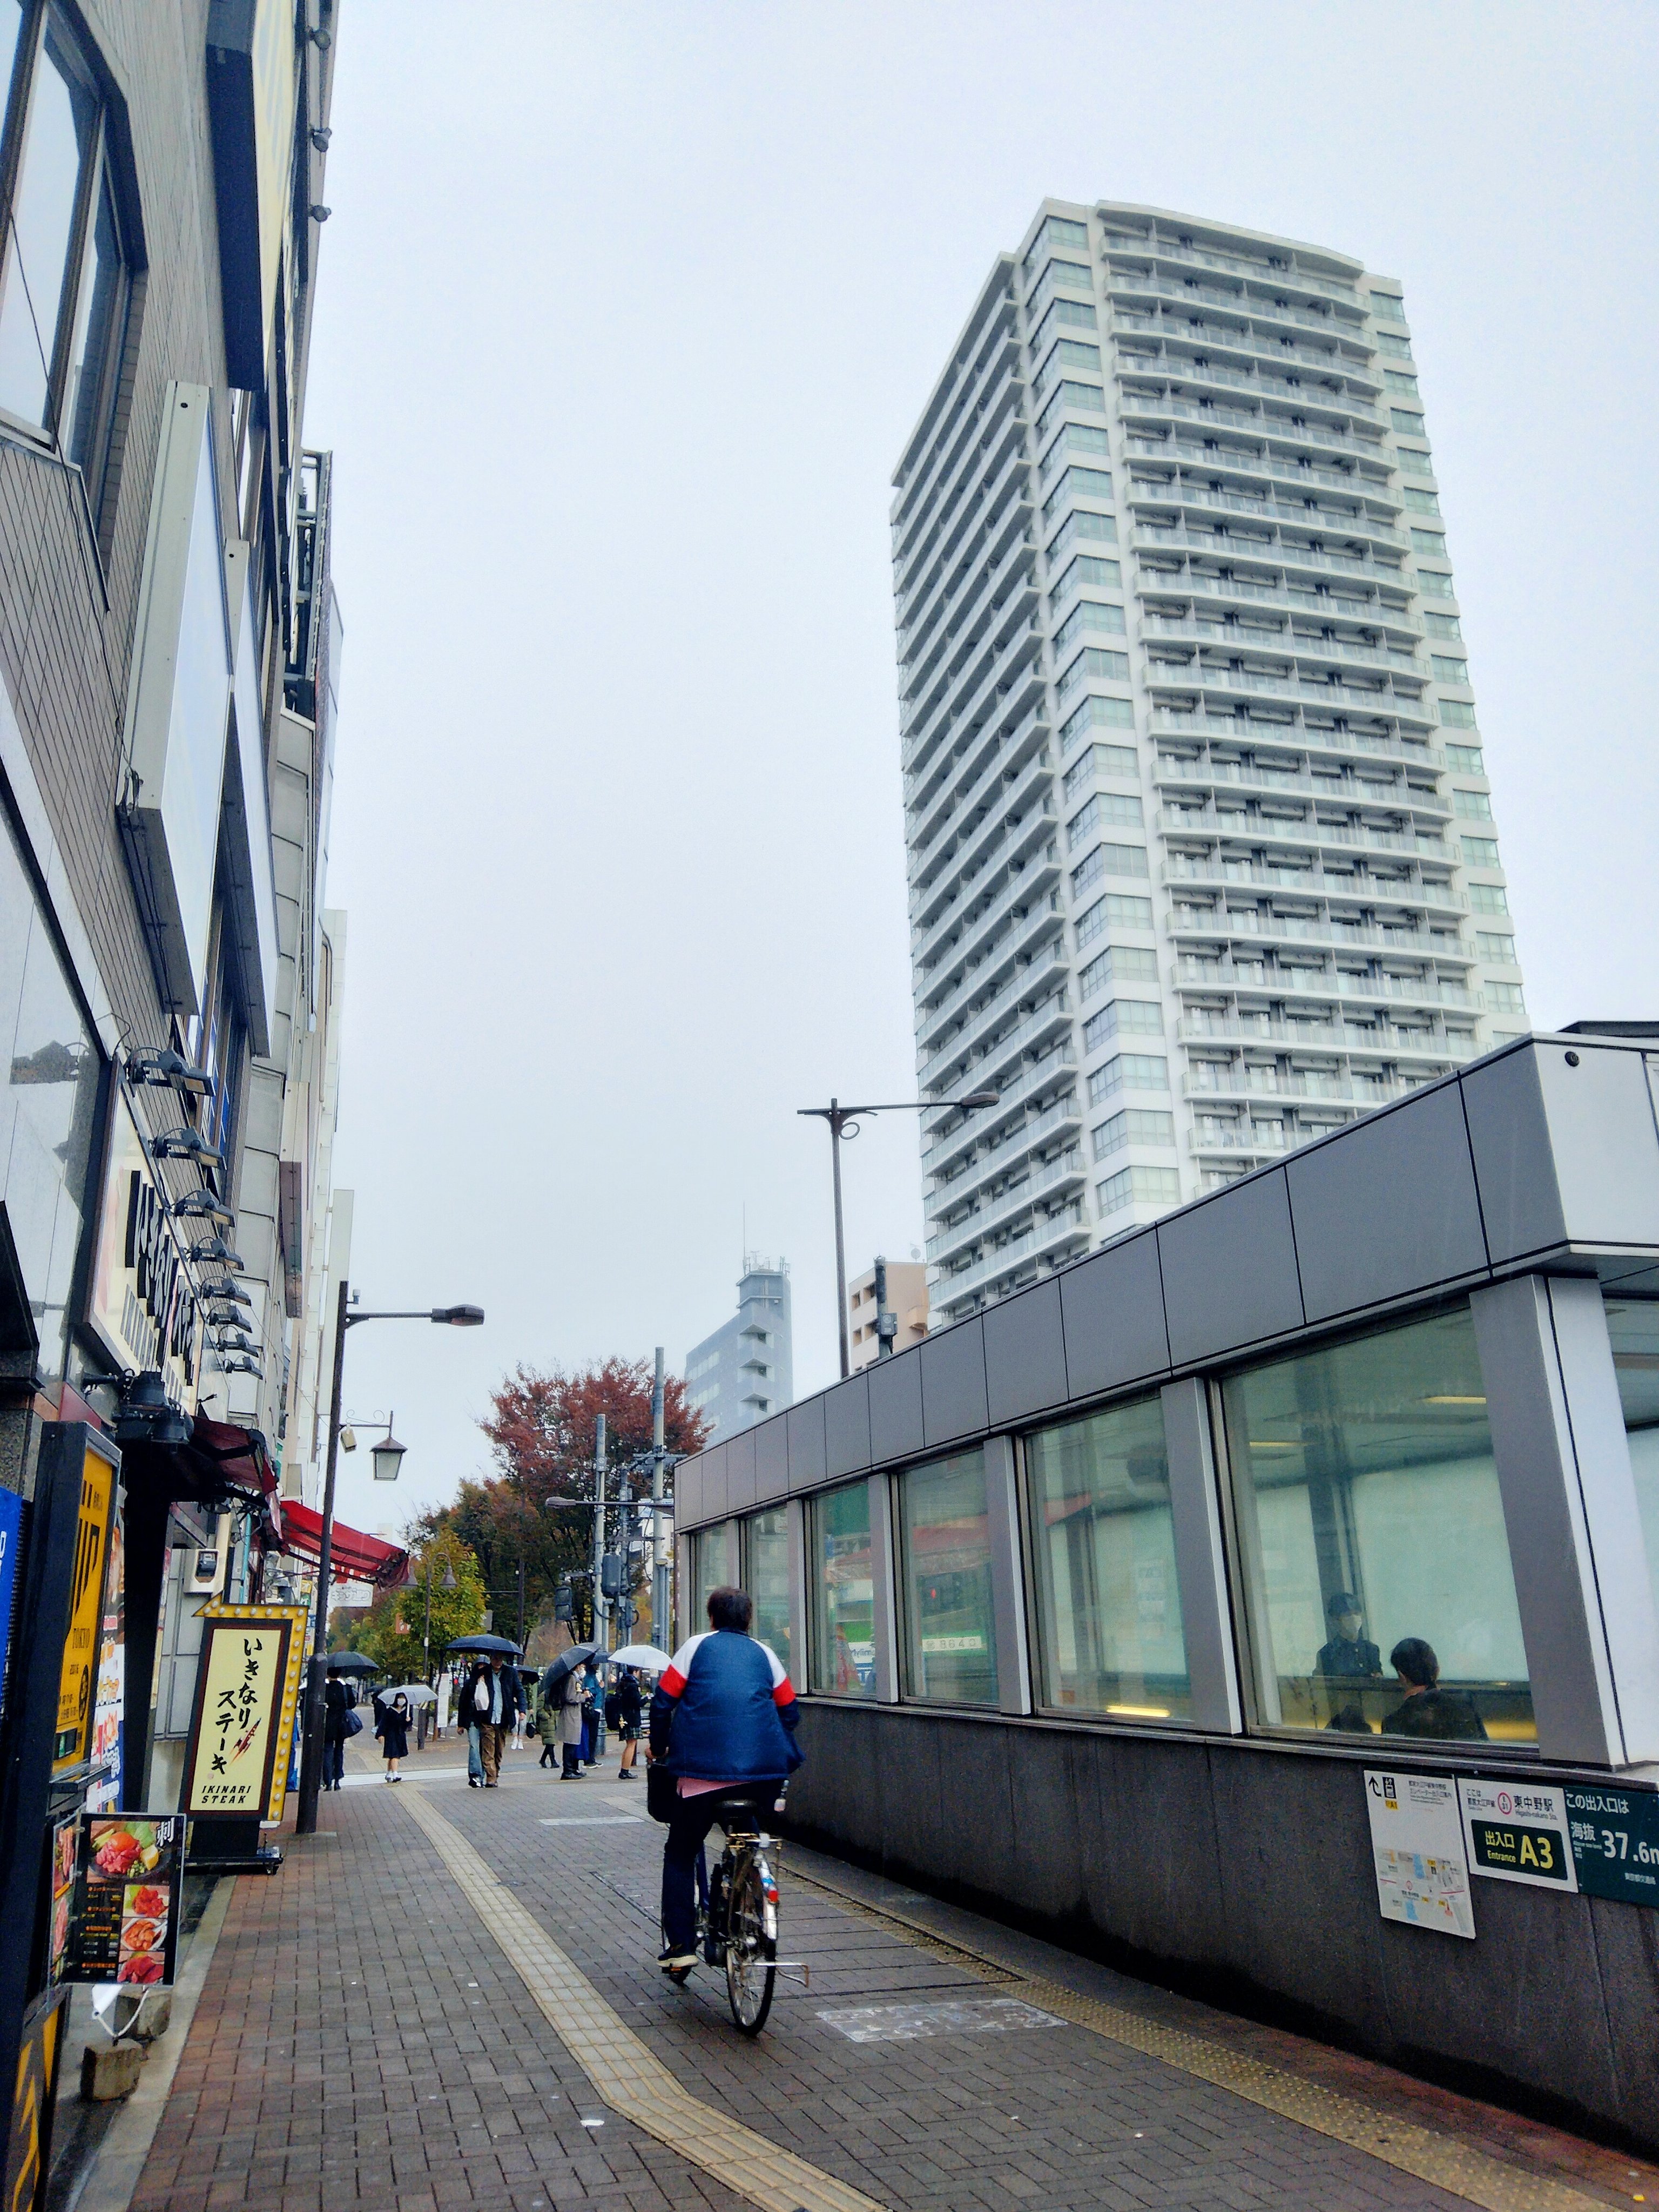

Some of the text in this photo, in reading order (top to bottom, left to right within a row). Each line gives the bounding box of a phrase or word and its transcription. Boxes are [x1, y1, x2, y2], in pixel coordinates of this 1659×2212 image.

[239, 1638, 262, 1730] いきなり
[211, 1690, 237, 1775] ステーキ
[201, 1785, 251, 1793] IKINARI
[201, 1795, 246, 1804] STEAK
[1514, 1795, 1554, 1812] 東中野駅
[1566, 1793, 1630, 1814] この出入口は
[156, 1817, 175, 1847] 刺
[1485, 1830, 1515, 1849] 出入口
[1571, 1821, 1596, 1841] 海抜
[1487, 1850, 1516, 1863] Entrance
[1520, 1835, 1553, 1869] A3
